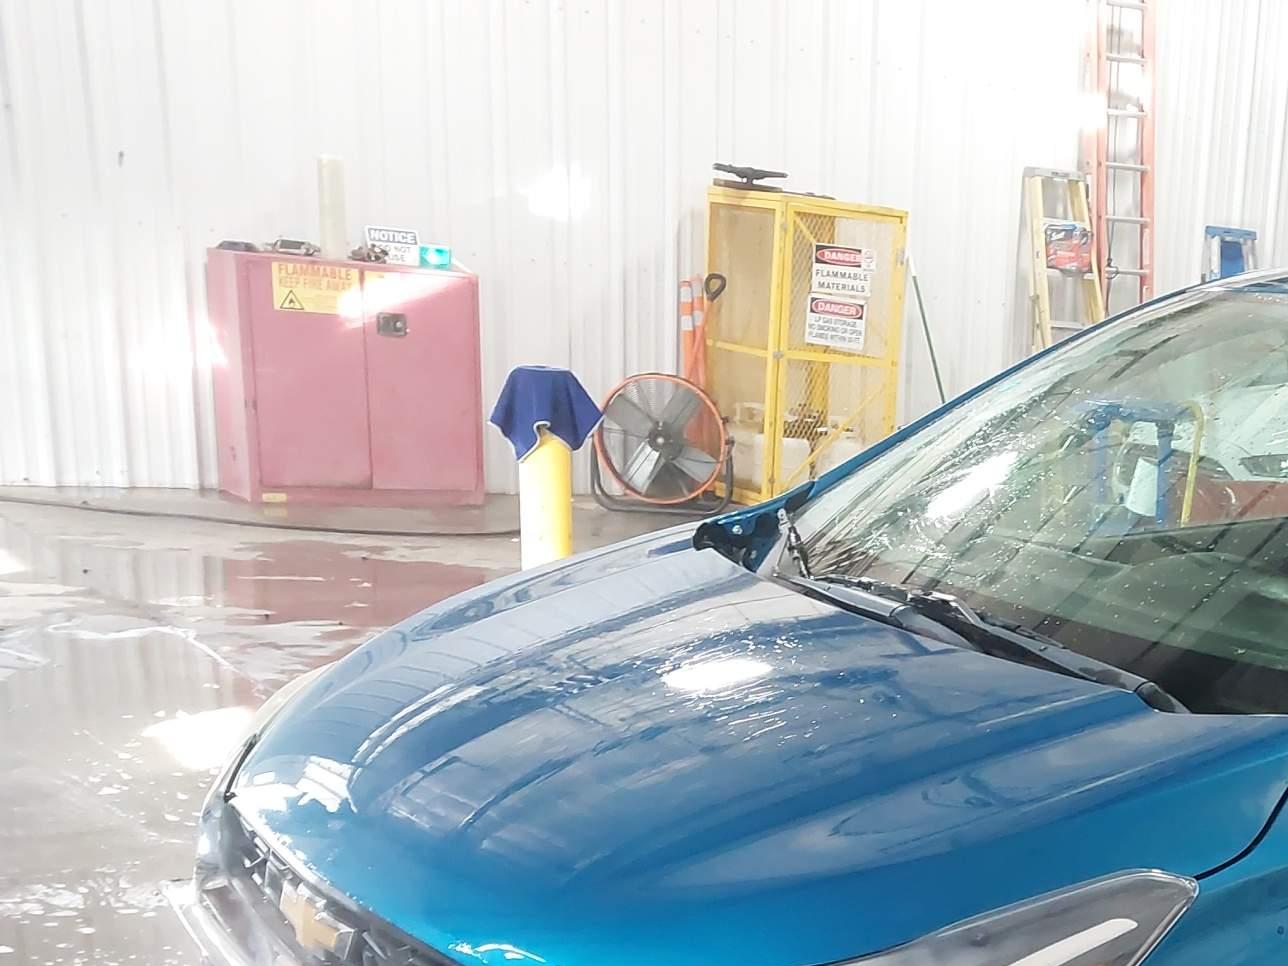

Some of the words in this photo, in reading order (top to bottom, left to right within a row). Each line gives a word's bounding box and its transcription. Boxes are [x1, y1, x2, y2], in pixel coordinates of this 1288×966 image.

[370, 229, 416, 244] NOTICE
[279, 263, 352, 280] FLAMMABLE
[816, 269, 868, 281] FLAMMABLE
[817, 281, 866, 293] MATERIALS
[818, 302, 857, 316] DANGER
